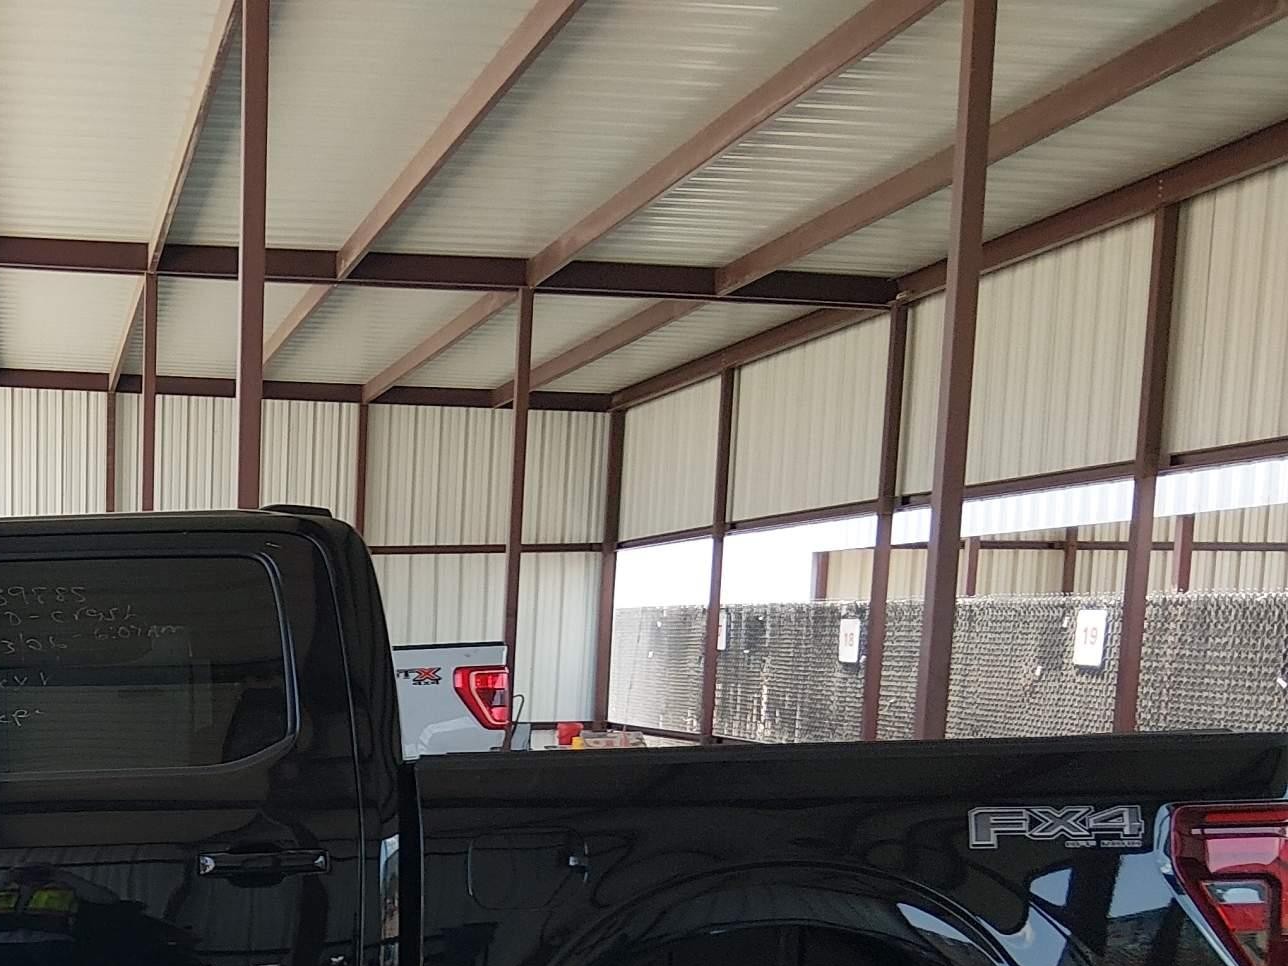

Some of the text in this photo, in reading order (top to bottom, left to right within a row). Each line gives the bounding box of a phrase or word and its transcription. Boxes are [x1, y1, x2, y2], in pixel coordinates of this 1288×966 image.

[841, 631, 855, 648] 18
[1083, 625, 1098, 646] 19
[968, 804, 1145, 849] FX4
